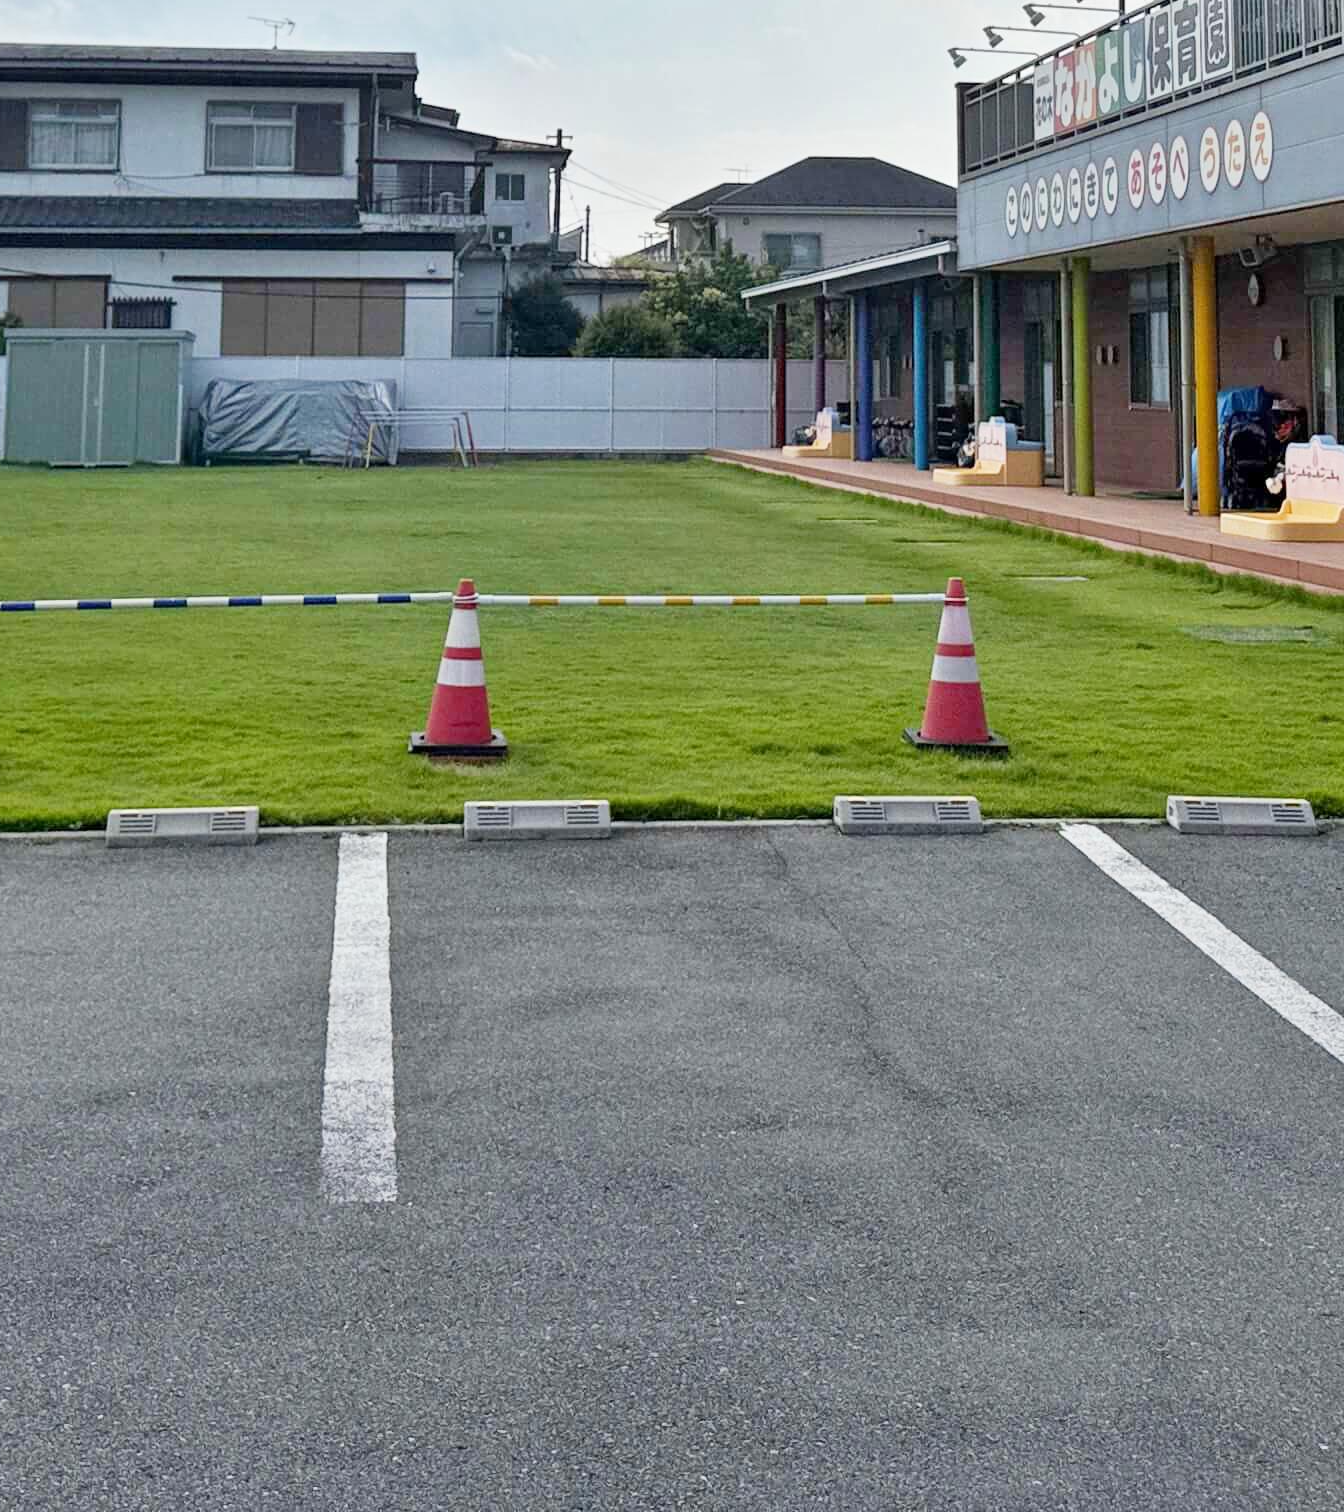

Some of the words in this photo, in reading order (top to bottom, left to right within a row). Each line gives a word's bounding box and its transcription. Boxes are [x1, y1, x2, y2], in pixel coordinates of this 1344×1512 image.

[1008, 164, 1114, 225] このにわにきて
[1130, 147, 1186, 195] あそべ
[1203, 122, 1269, 179] うたえ
